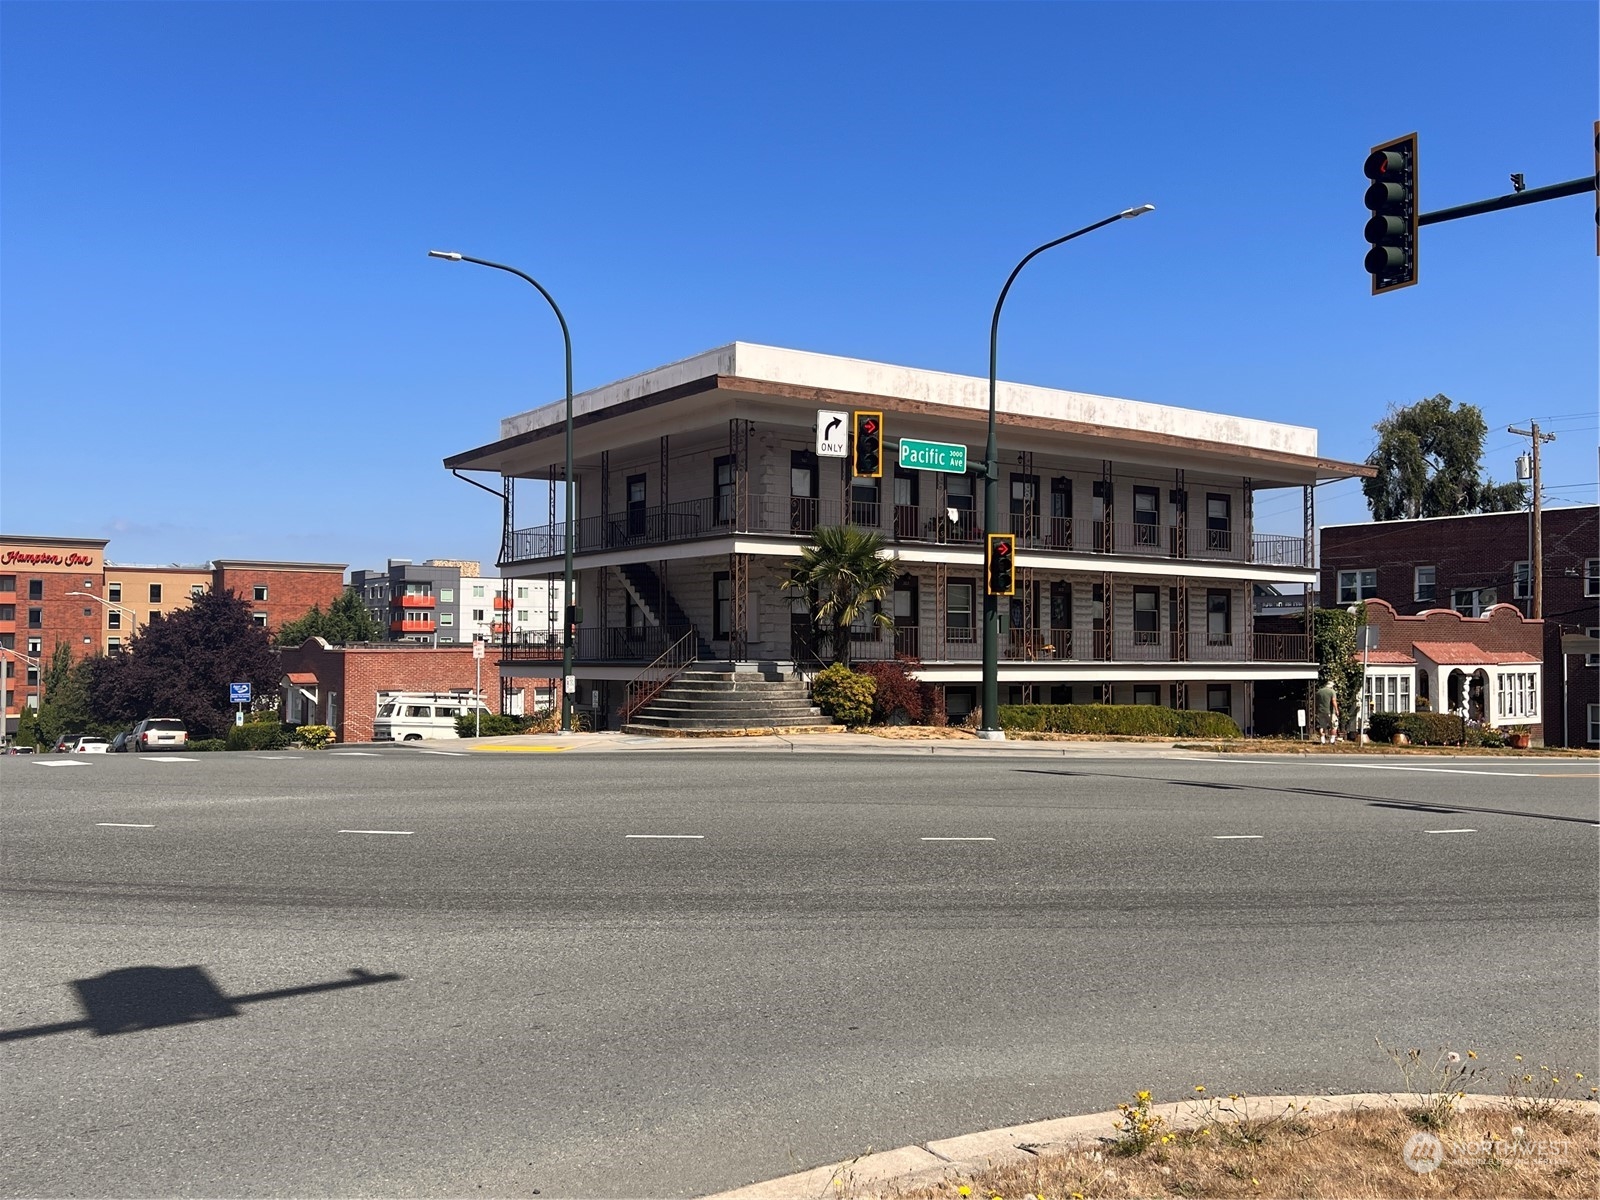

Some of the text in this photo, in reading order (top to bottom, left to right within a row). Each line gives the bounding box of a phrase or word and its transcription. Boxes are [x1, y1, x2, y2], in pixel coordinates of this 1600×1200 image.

[821, 442, 843, 453] ONLY
[902, 445, 946, 466] Pacific
[950, 450, 963, 458] 3000
[950, 458, 963, 468] Ave
[1, 551, 93, 567] Hampton Inn
